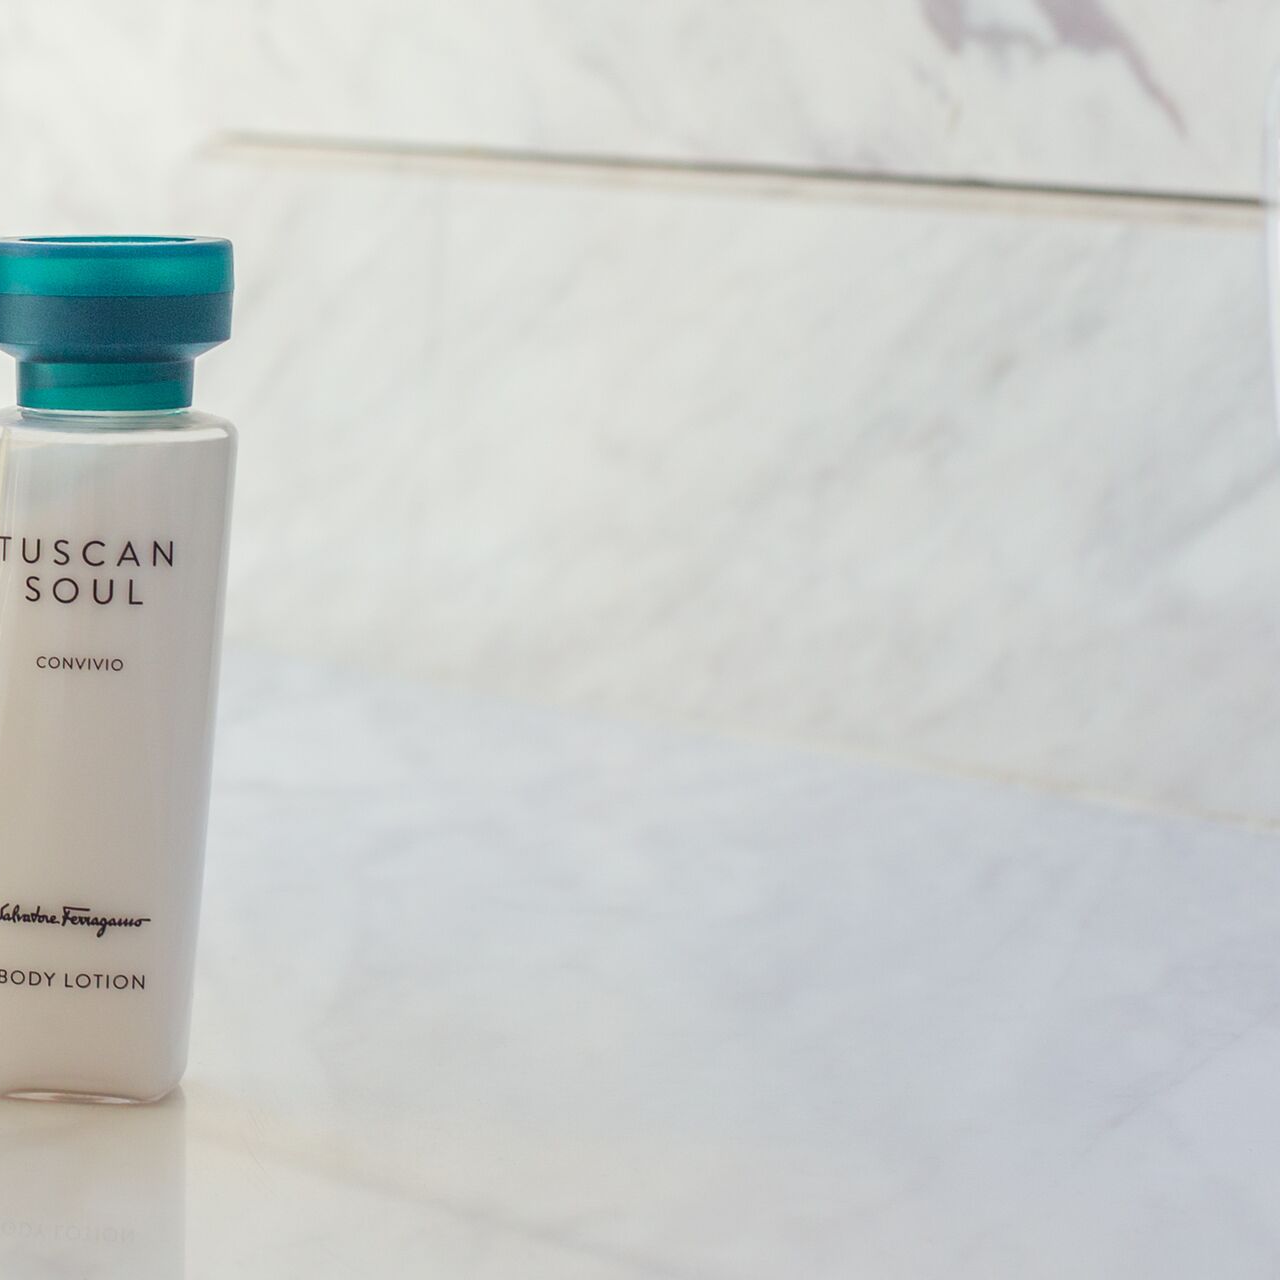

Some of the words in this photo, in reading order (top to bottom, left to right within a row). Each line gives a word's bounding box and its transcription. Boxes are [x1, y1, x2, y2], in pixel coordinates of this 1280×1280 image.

[25, 576, 143, 605] SOUL
[36, 656, 123, 671] CONVIVIO
[61, 906, 149, 936] Ferragamo
[65, 973, 145, 989] LOTION
